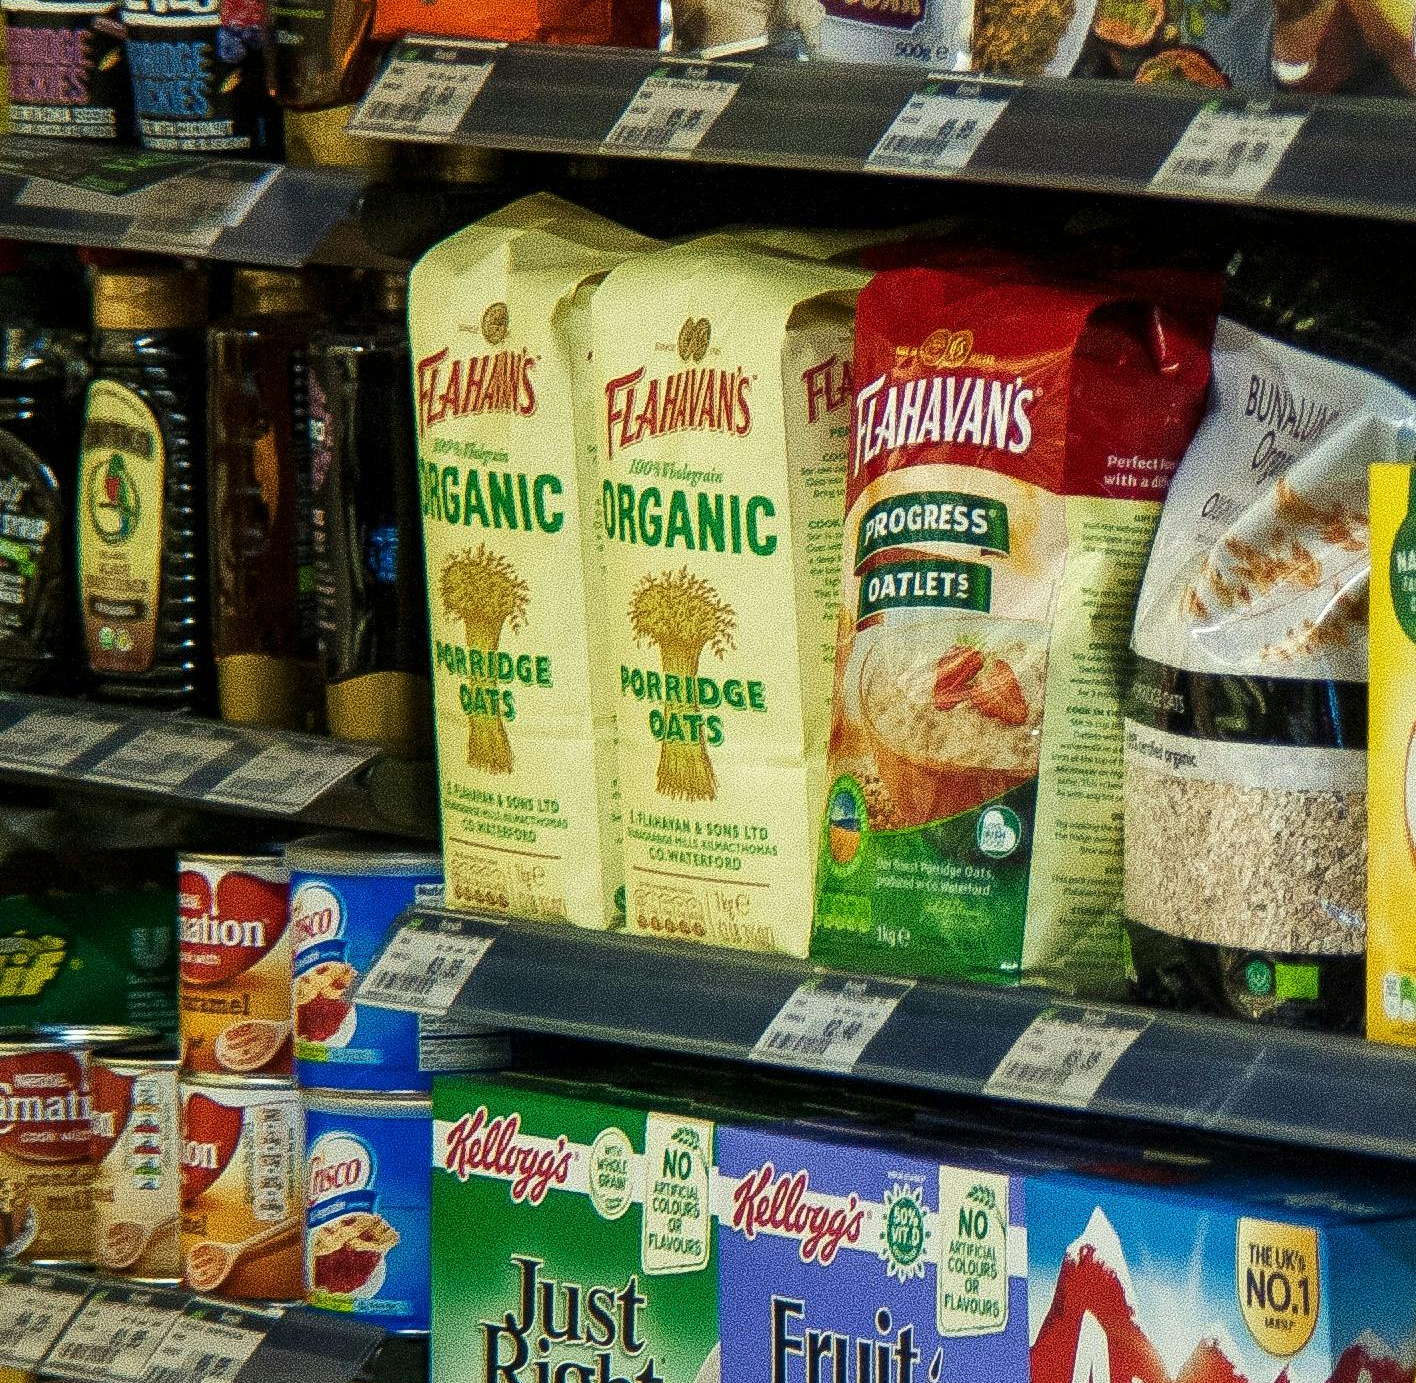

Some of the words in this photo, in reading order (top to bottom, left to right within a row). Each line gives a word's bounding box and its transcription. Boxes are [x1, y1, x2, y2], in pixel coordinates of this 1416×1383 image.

[850, 375, 1037, 480] FLAHAVAN'S
[1103, 472, 1138, 488] with
[1105, 454, 1156, 473] Perfect
[602, 478, 779, 557] ORGANIC
[861, 502, 991, 545] PROGRESS
[435, 640, 553, 688] PORRIDGE
[459, 683, 517, 720] OATS
[620, 665, 767, 714] PORRIDGE
[648, 709, 725, 746] OATS
[705, 820, 741, 840] SONS
[743, 823, 769, 842] LTD
[445, 1108, 573, 1202] Kellogg's
[662, 1150, 692, 1181] NO
[650, 1197, 701, 1220] COLOURS
[667, 1218, 683, 1234] OR
[732, 1165, 865, 1263] Kellogg's
[958, 1206, 990, 1241] NO
[647, 1233, 703, 1257] FLAVOURS
[1248, 1243, 1275, 1268] THE
[1275, 1246, 1306, 1274] UK'S
[947, 1257, 998, 1281] COLOURS
[963, 1278, 980, 1294] OR
[502, 1254, 646, 1354] Just
[943, 1292, 1001, 1319] FLAVOURS
[1245, 1268, 1311, 1317] NO.1
